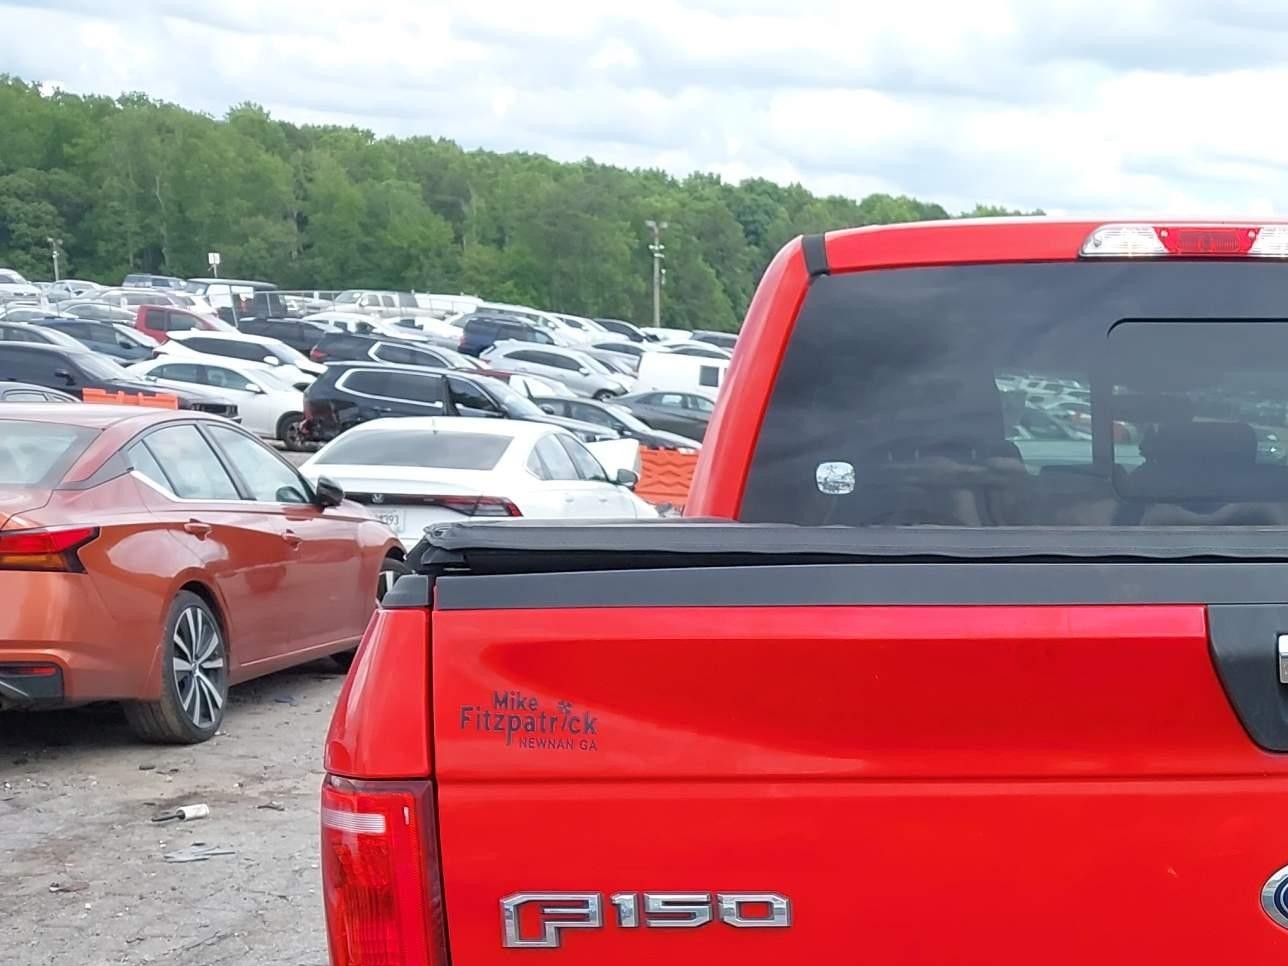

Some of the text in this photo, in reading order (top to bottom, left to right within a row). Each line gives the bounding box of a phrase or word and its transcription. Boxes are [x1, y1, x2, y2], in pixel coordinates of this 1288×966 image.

[493, 691, 538, 711] Mike
[459, 702, 598, 746] Fitzpatrick
[519, 738, 597, 751] NEWNAN GA
